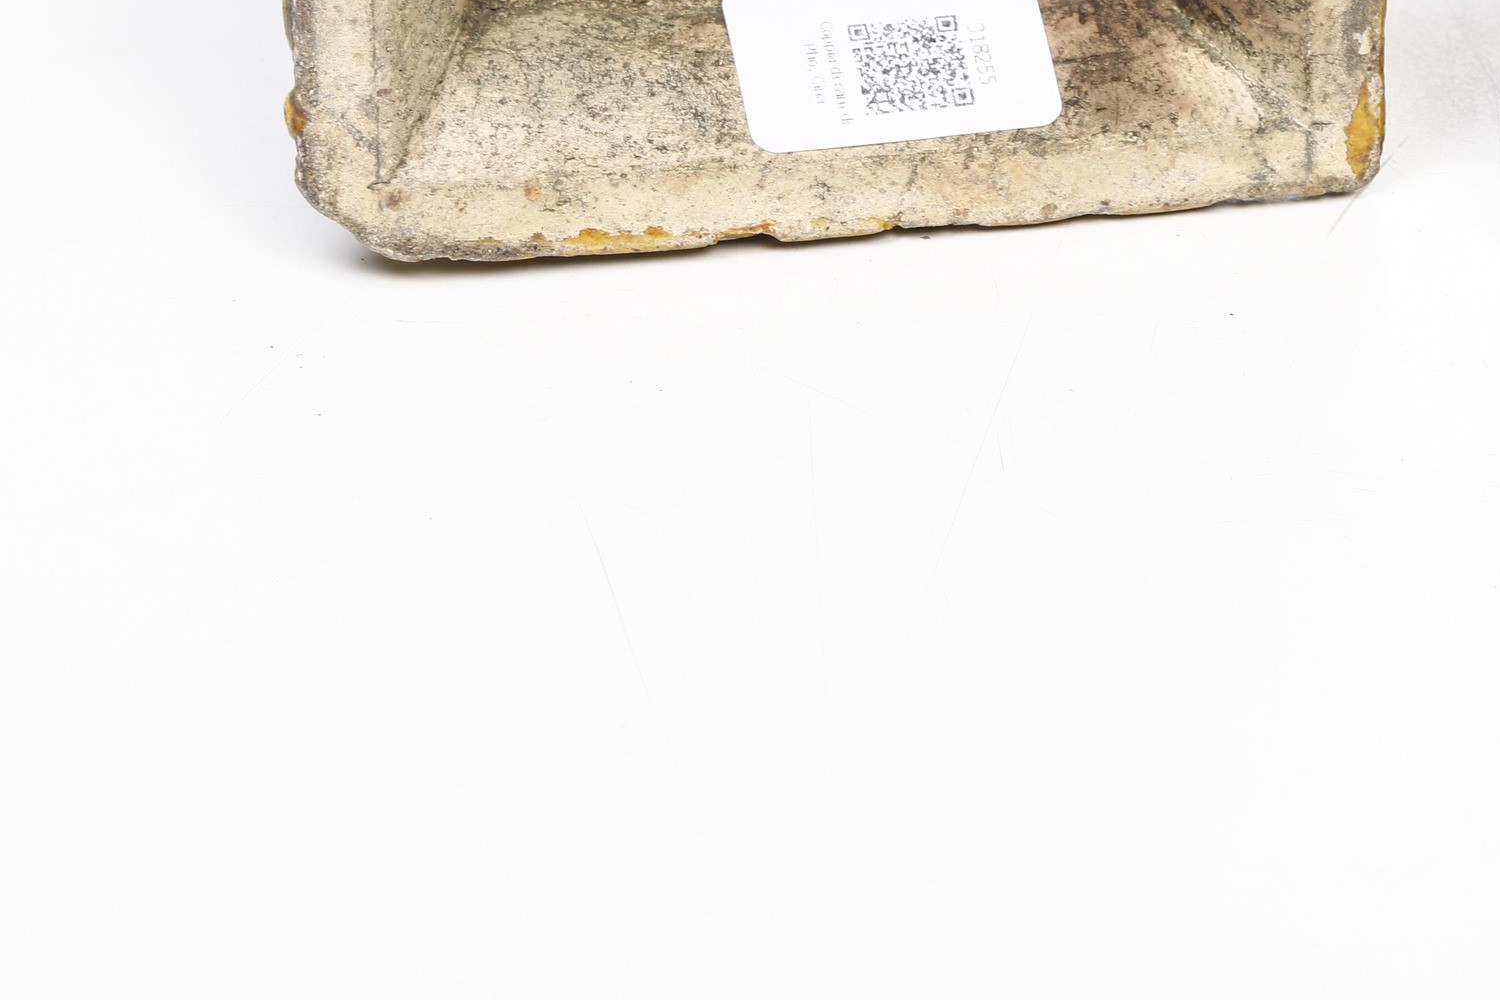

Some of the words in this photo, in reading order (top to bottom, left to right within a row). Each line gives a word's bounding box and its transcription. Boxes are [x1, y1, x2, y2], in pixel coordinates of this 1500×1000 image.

[820, 21, 838, 63] Coppia
[830, 66, 845, 79] di
[966, 22, 998, 85] 318255
